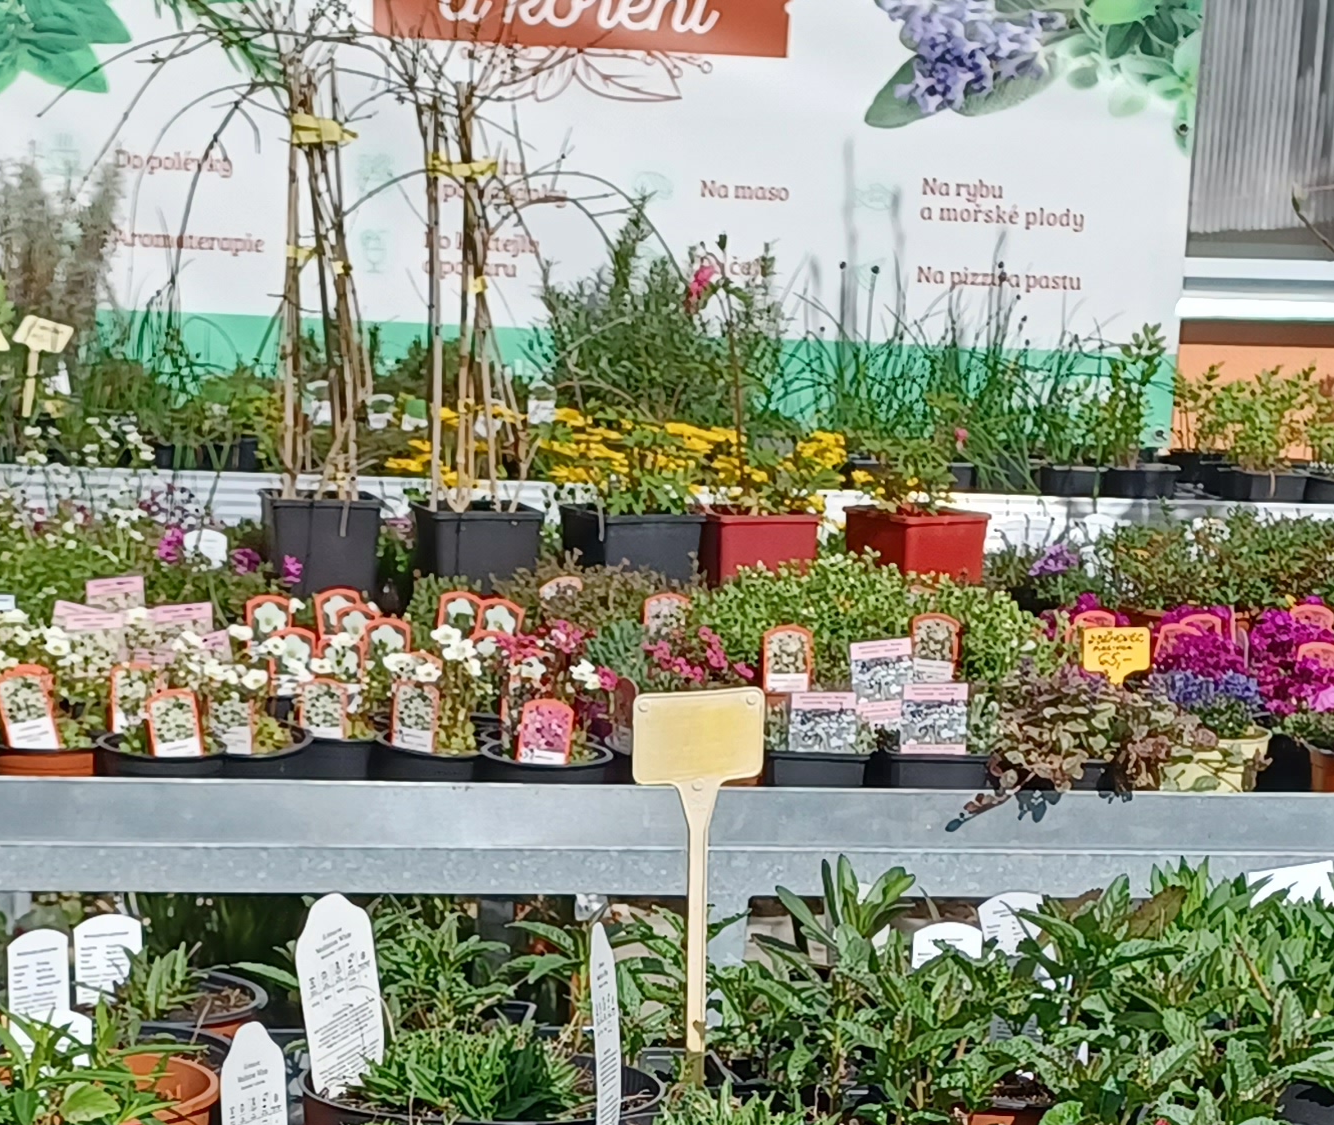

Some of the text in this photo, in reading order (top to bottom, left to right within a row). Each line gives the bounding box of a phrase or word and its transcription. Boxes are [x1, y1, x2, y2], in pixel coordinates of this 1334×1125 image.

[700, 179, 790, 201] Na maso
[921, 177, 1004, 203] Na rybu
[919, 203, 1085, 233] a mořské plody
[916, 266, 945, 284] Na
[1025, 273, 1082, 293] pastu
